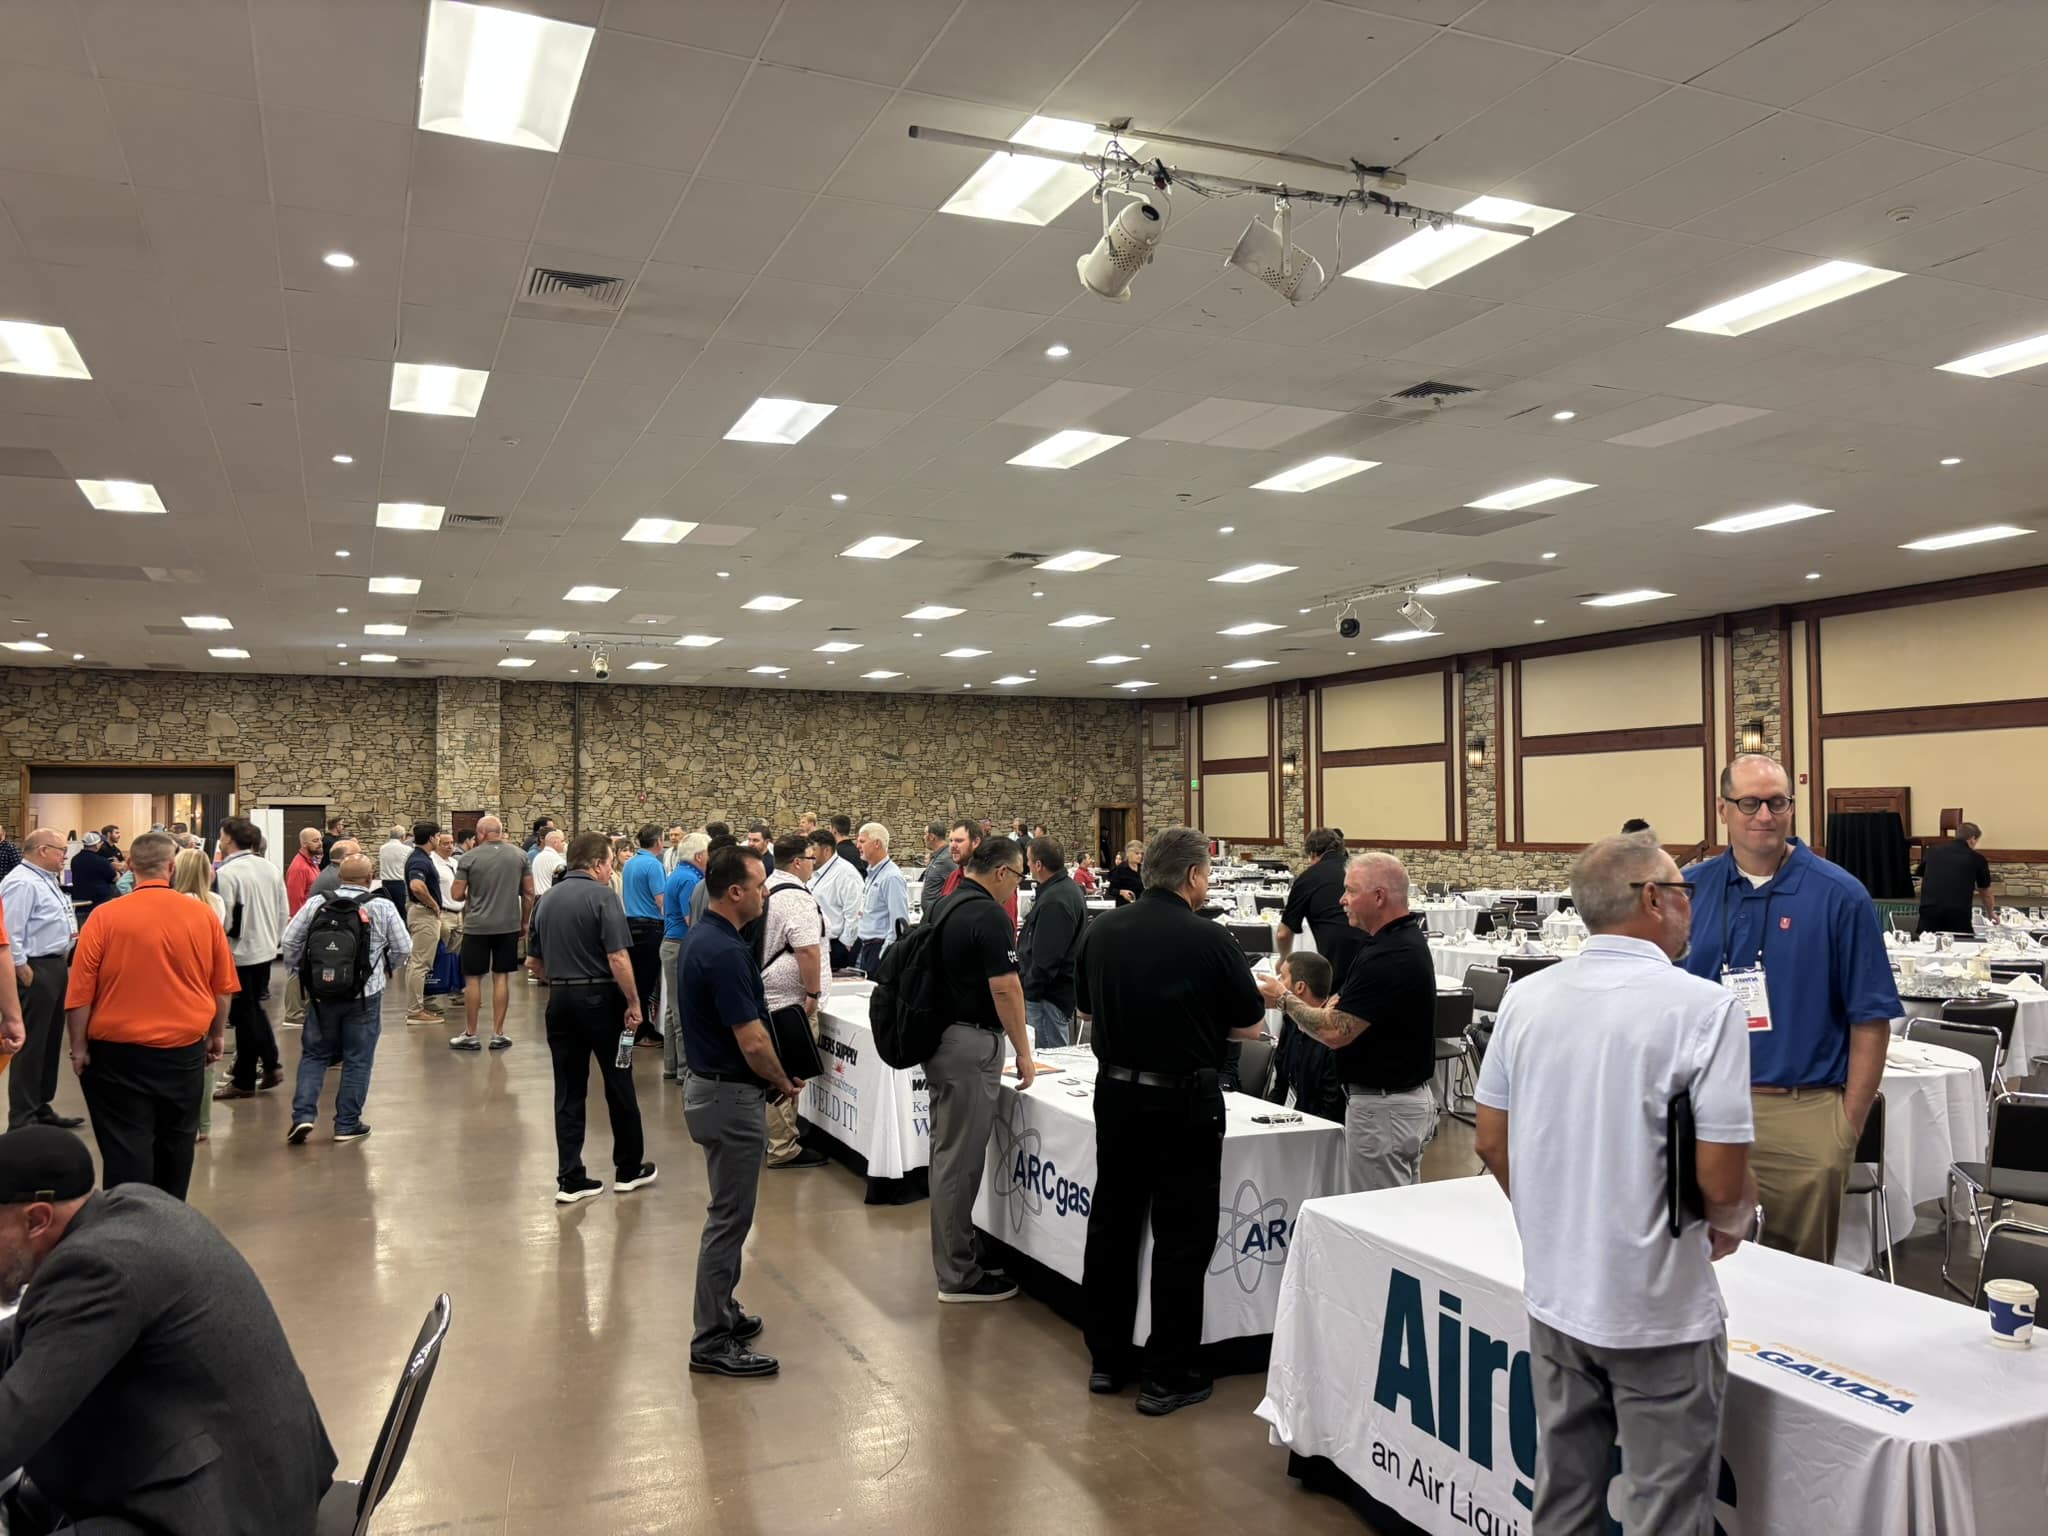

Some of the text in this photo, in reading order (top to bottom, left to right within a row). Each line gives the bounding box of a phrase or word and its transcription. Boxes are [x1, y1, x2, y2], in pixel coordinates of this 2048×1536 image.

[836, 1041, 858, 1067] SUPPLY
[808, 1080, 858, 1135] WELD IT!
[1012, 1149, 1091, 1217] ARCgas
[1756, 1350, 1914, 1414] GAWDA
[1371, 1441, 1401, 1480] an
[1408, 1458, 1444, 1505] Air
